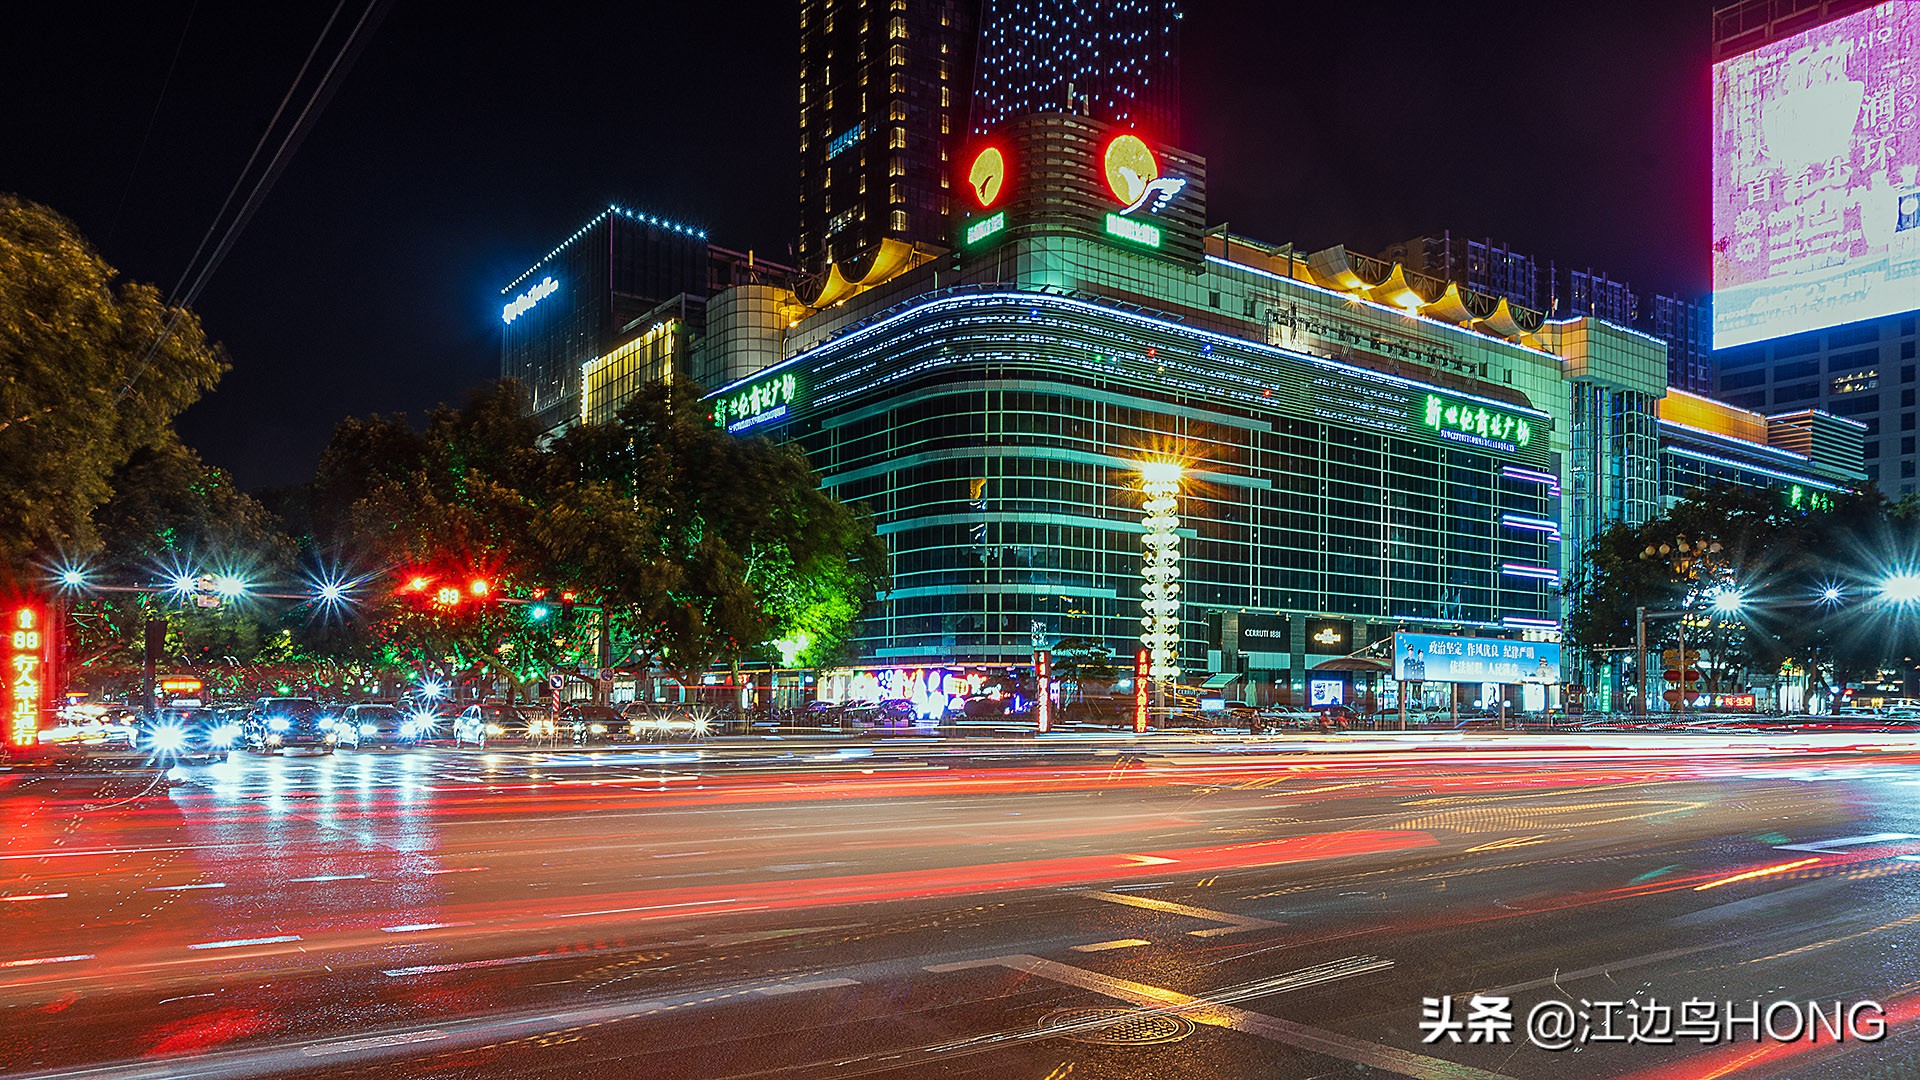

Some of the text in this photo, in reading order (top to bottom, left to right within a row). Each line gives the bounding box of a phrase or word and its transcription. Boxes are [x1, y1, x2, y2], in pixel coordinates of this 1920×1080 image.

[1425, 394, 1530, 446] 新世纪商业广场
[1428, 640, 1535, 660] 政治坚定 作风优良 纪律严明
[12, 654, 39, 746] 行人禁止通行
